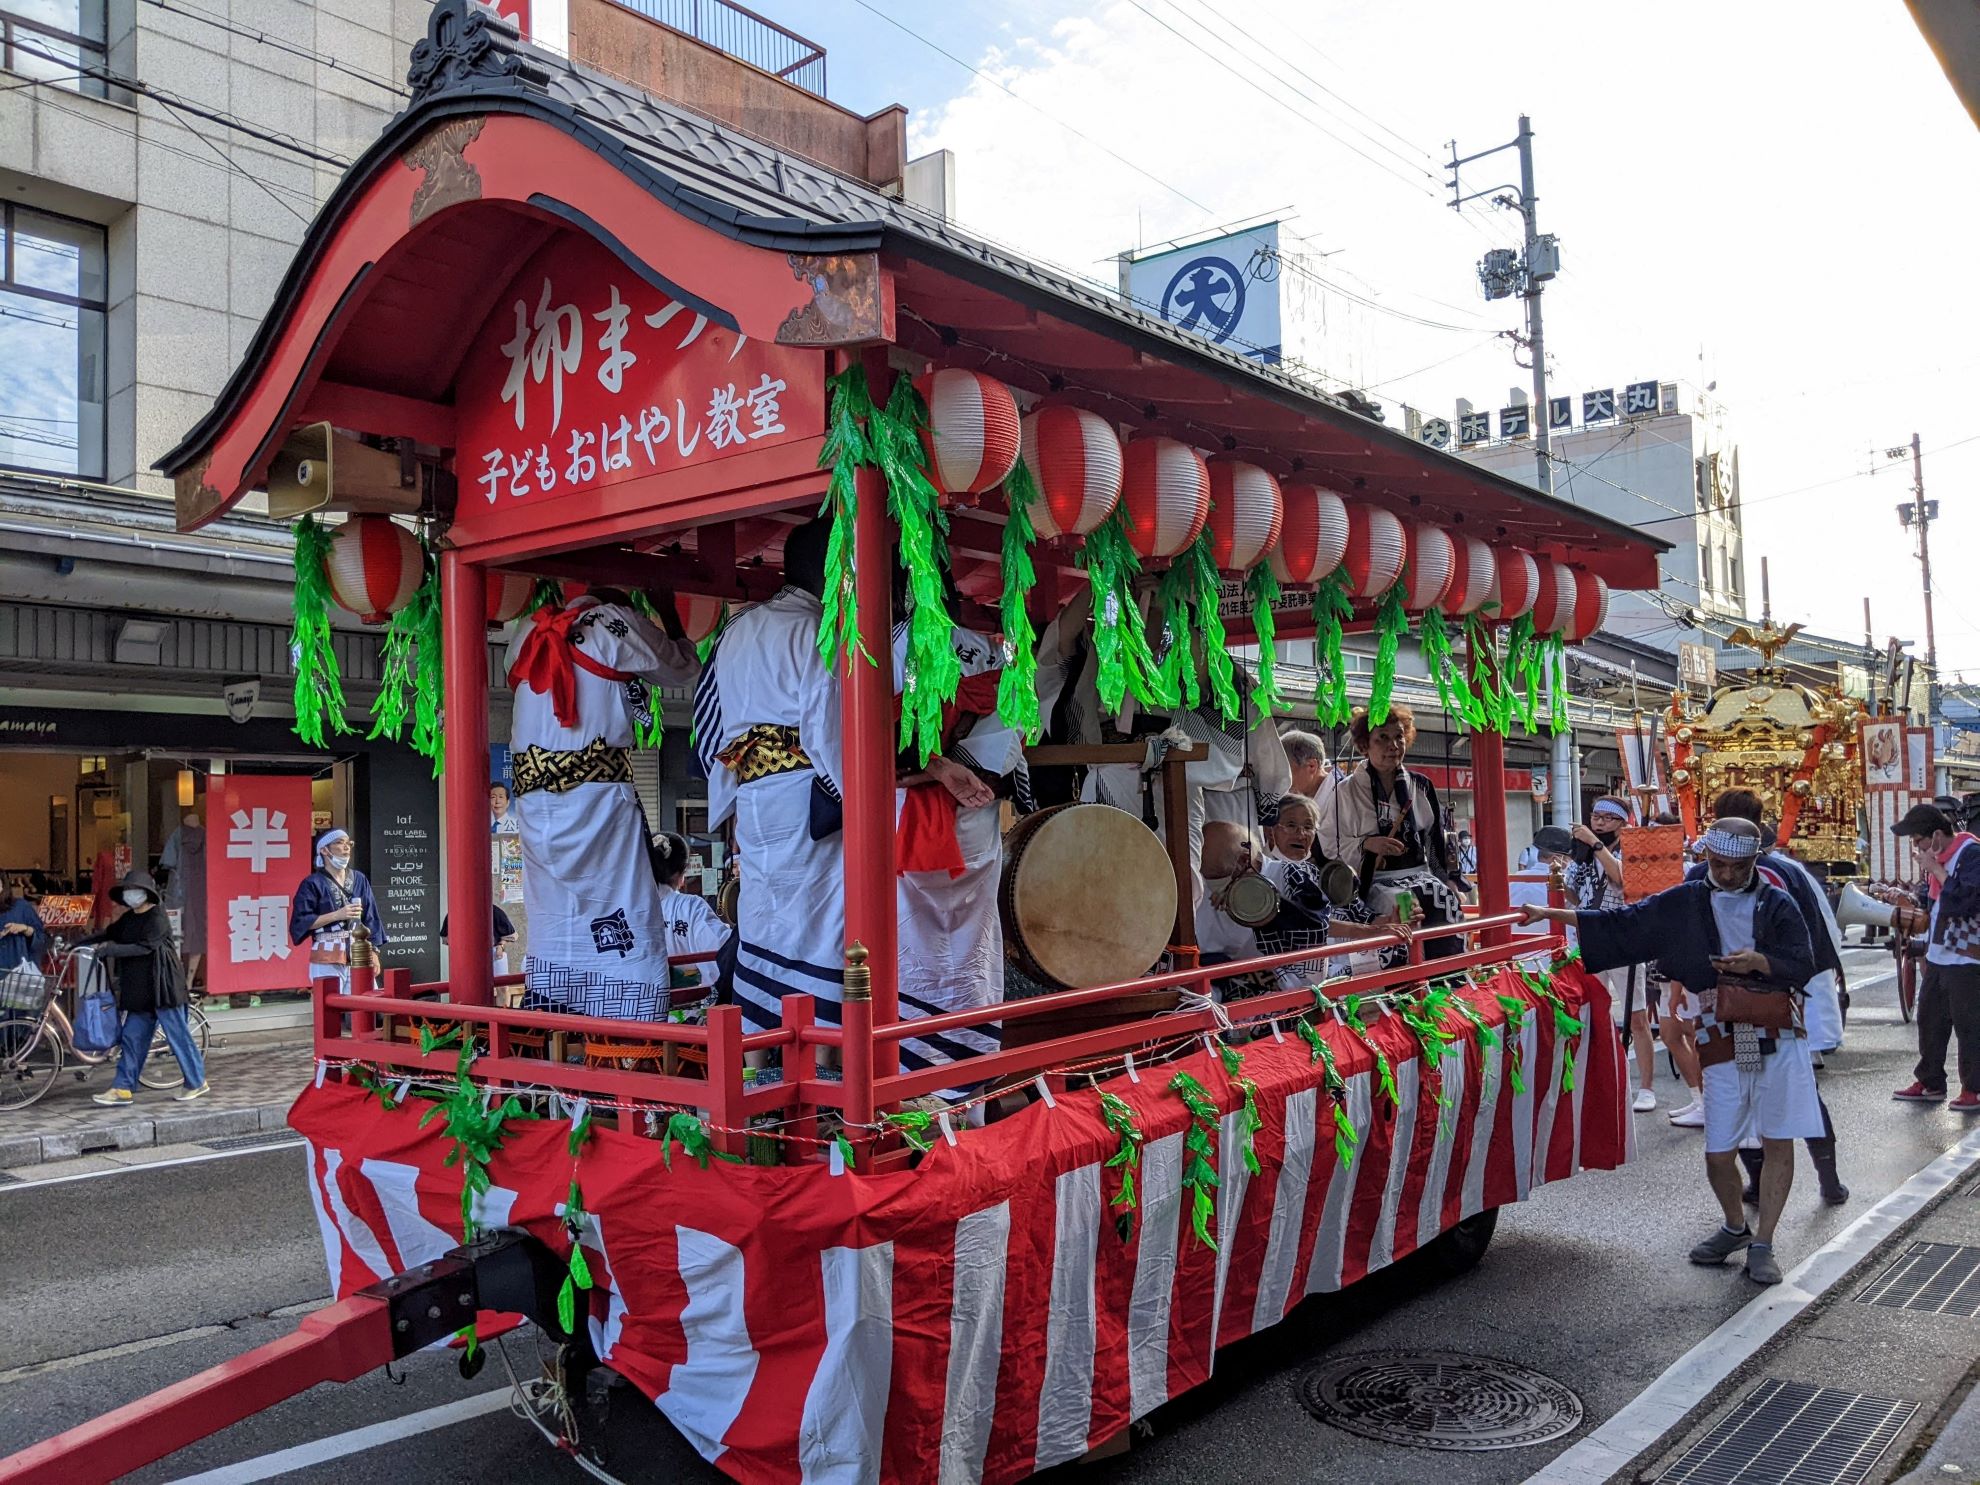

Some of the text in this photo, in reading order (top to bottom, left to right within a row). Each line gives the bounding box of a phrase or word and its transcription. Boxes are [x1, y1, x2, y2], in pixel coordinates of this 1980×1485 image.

[500, 277, 747, 438] 柳まつ
[477, 373, 787, 505] 子どもおはやし教室
[226, 807, 292, 964] 半額
[387, 888, 425, 898] BALMAIN
[387, 947, 425, 956] NONA
